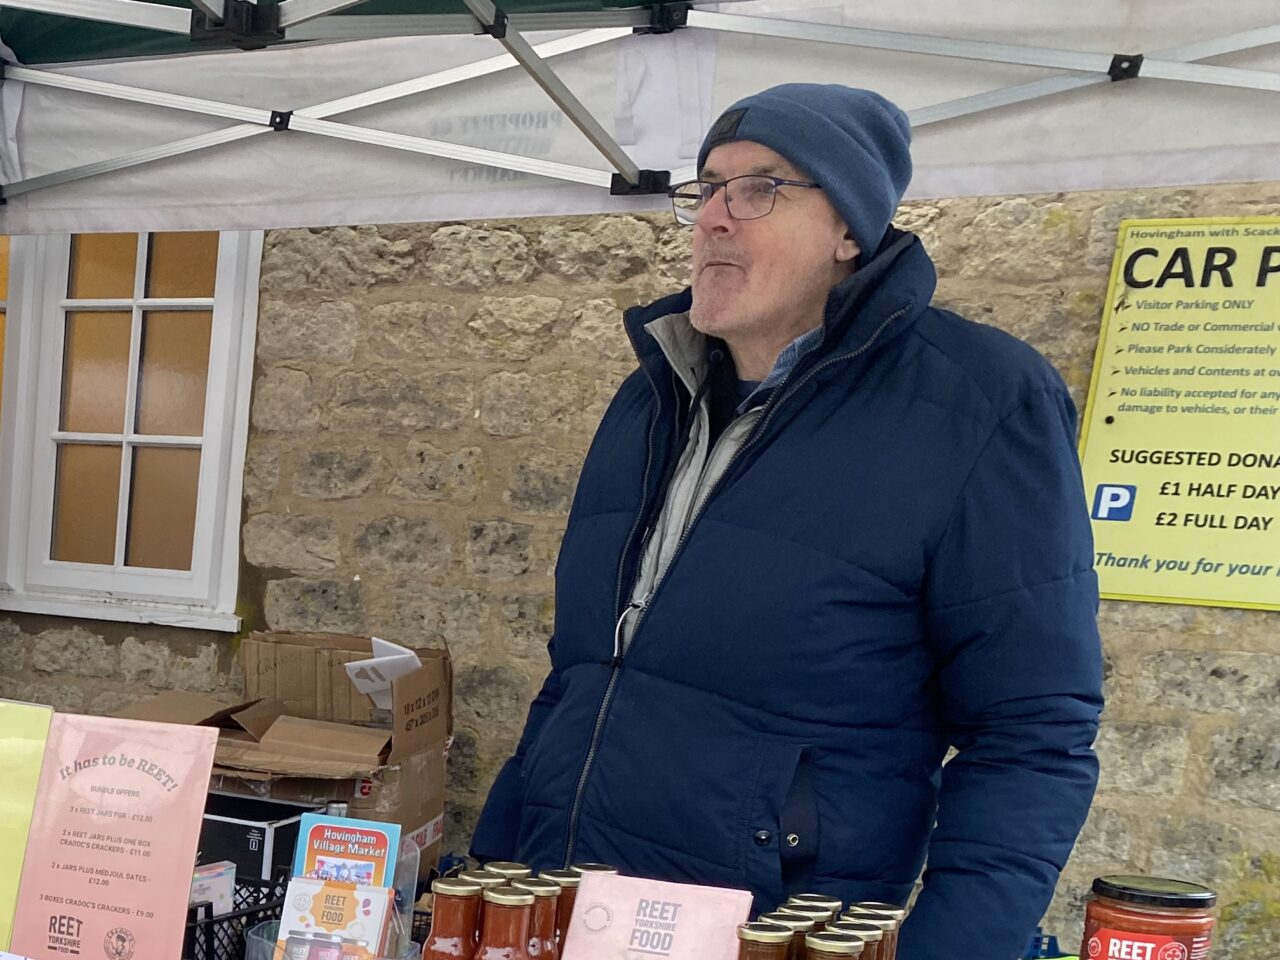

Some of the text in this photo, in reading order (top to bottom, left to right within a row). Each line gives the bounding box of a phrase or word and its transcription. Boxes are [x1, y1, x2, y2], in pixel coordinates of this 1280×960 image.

[1130, 229, 1205, 239] Hovingham
[1209, 228, 1239, 237] with
[1123, 246, 1237, 288] CAR
[1136, 300, 1255, 311] Visitor Parking ONLY
[1131, 322, 1275, 332] NO Trade or Commercial
[1127, 344, 1277, 356] Please Park Considerately
[1124, 366, 1170, 376] Vehicles
[1173, 366, 1196, 376] and
[1198, 366, 1250, 376] Contents
[1253, 367, 1265, 376] at
[1121, 388, 1137, 397] No
[1139, 387, 1182, 399] liability
[1184, 388, 1237, 400] accepted
[1240, 388, 1257, 399] for
[1118, 402, 1163, 415] damage
[1166, 404, 1178, 413] to
[1233, 406, 1247, 414] or
[1249, 405, 1279, 415] their
[1109, 449, 1222, 467] SUGGESTED
[1159, 481, 1280, 500] £1 HALF DAY
[1097, 486, 1131, 518] P
[1155, 512, 1274, 531] £2 FULL DAY
[1095, 552, 1273, 577] Thank you for your
[59, 753, 179, 792] It has to be REET!
[324, 828, 377, 845] Hovingham
[313, 840, 385, 858] Village Market
[324, 894, 348, 906] REET
[321, 911, 344, 924] FOOD
[636, 898, 682, 922] REET
[634, 918, 678, 932] YORKSHIRE
[629, 928, 674, 951] FOOD
